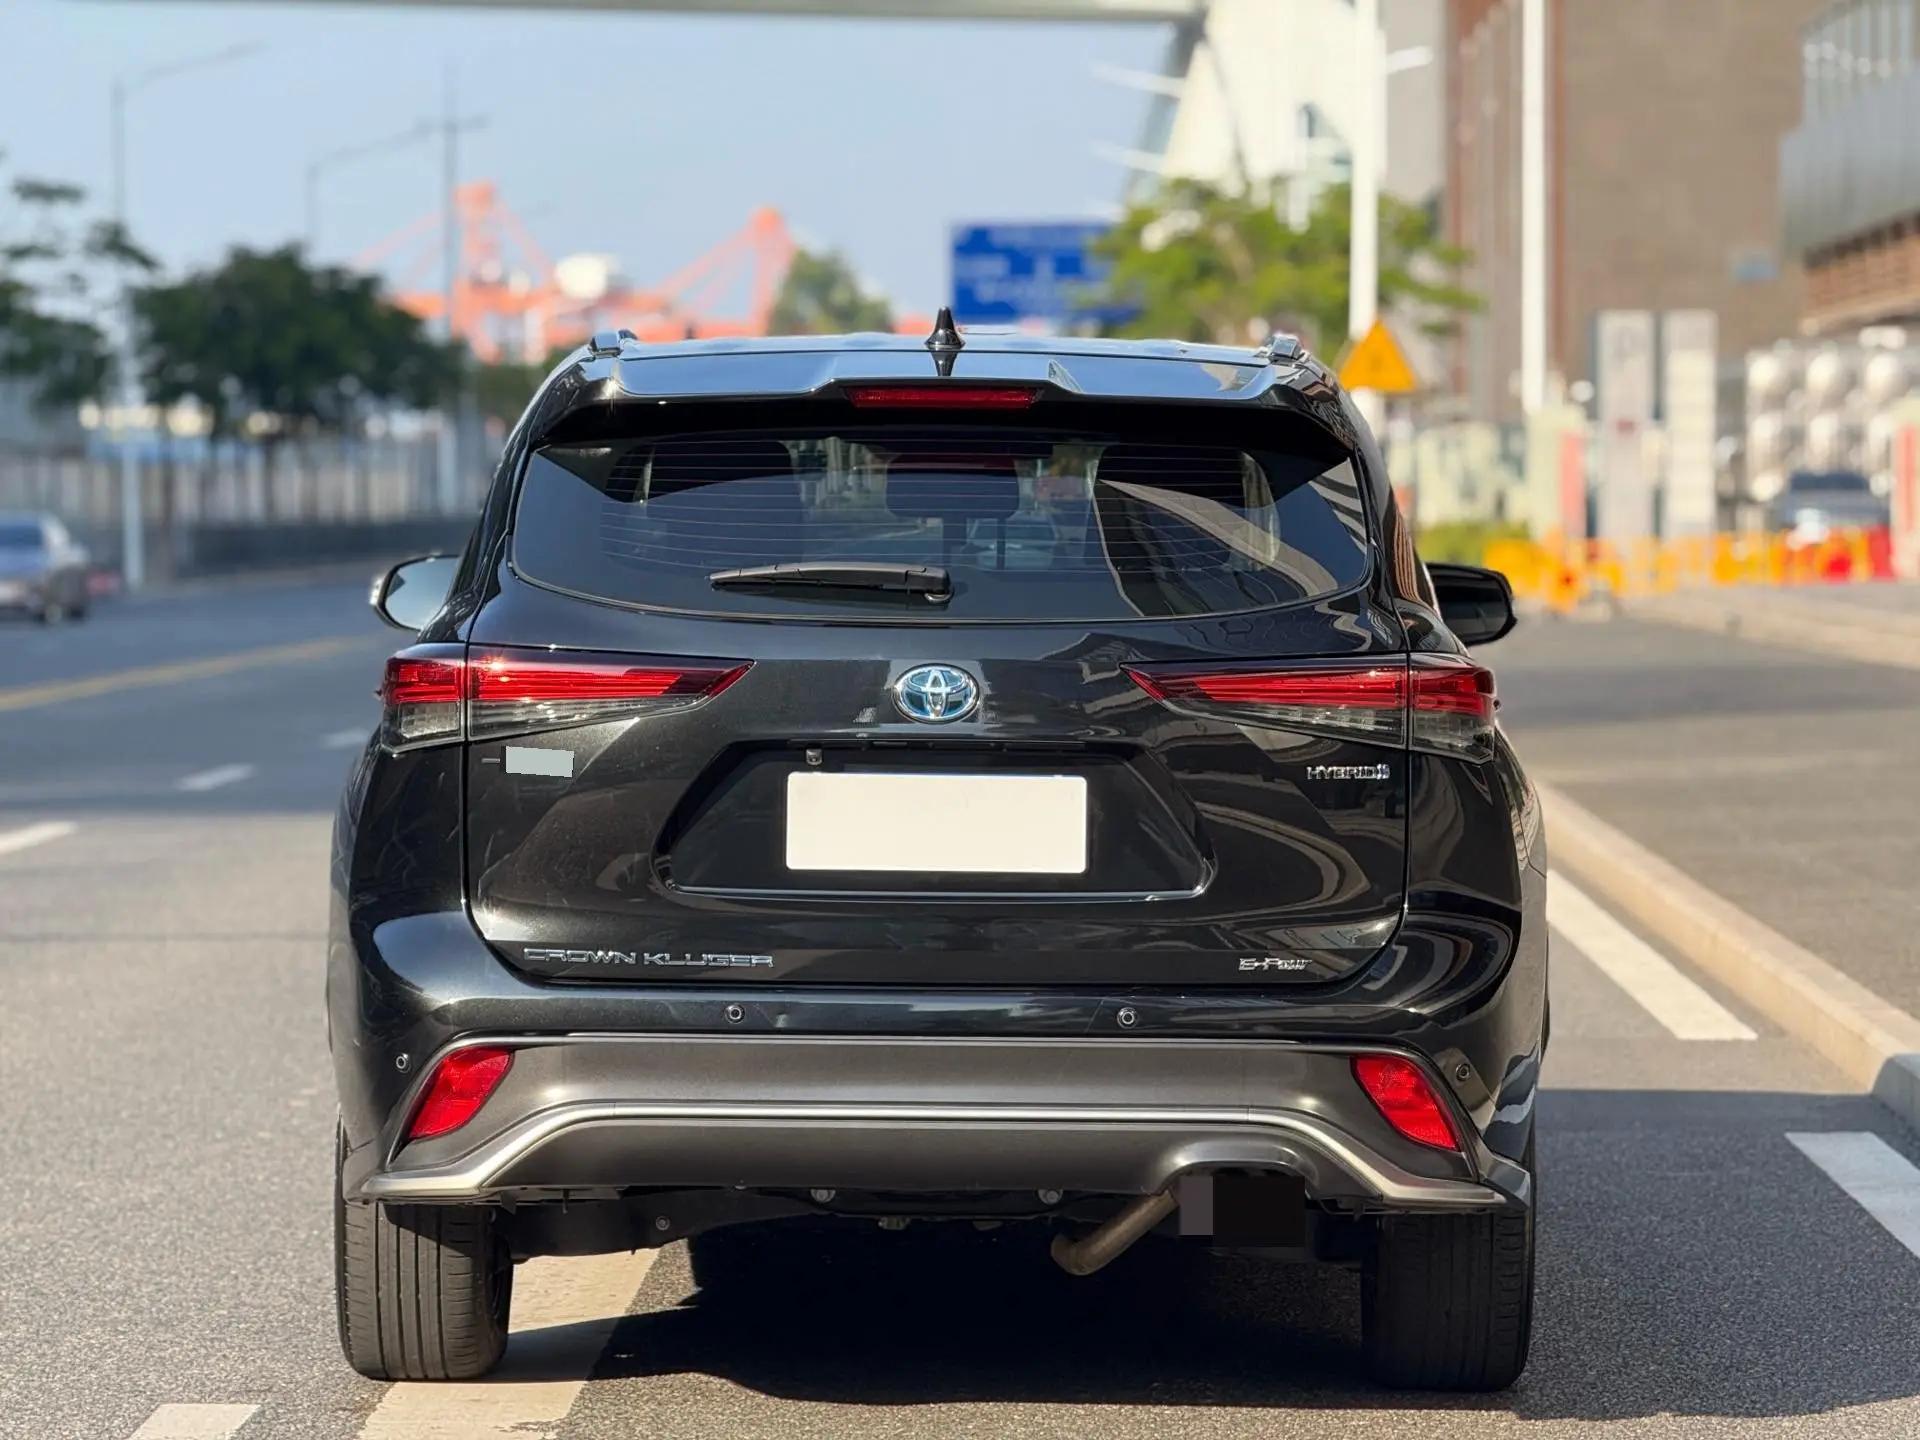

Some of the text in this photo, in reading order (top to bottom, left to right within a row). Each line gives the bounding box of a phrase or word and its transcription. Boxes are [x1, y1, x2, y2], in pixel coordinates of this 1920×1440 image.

[1306, 765, 1377, 779] HYBRID
[523, 947, 774, 967] CROWN KLUGER
